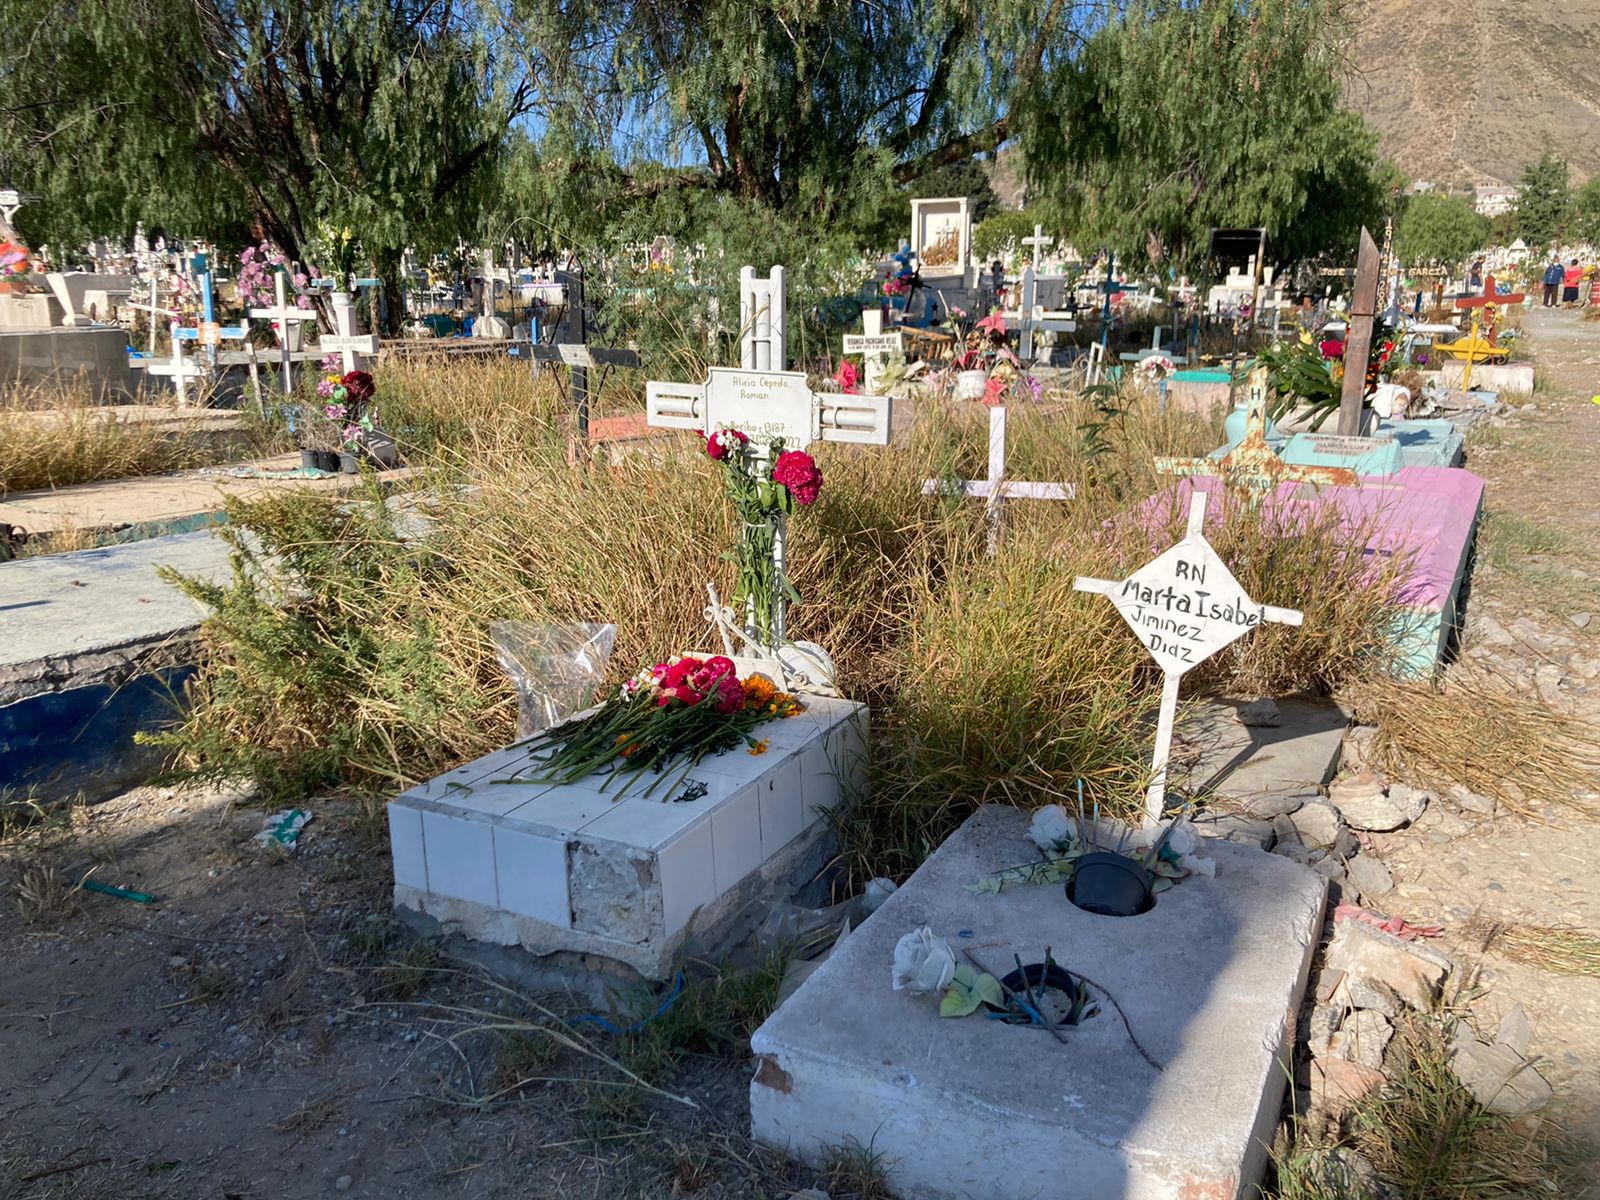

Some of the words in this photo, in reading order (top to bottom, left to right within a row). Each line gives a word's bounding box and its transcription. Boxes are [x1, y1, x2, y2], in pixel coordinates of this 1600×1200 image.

[1408, 266, 1448, 277] GARCIA
[732, 376, 757, 388] Alicia
[740, 390, 769, 400] Roman
[1175, 559, 1206, 585] RN
[1122, 579, 1191, 614] Marta
[1195, 590, 1267, 627] Isabel
[1131, 605, 1205, 642] Jiminez
[1149, 634, 1195, 663] Diaz
